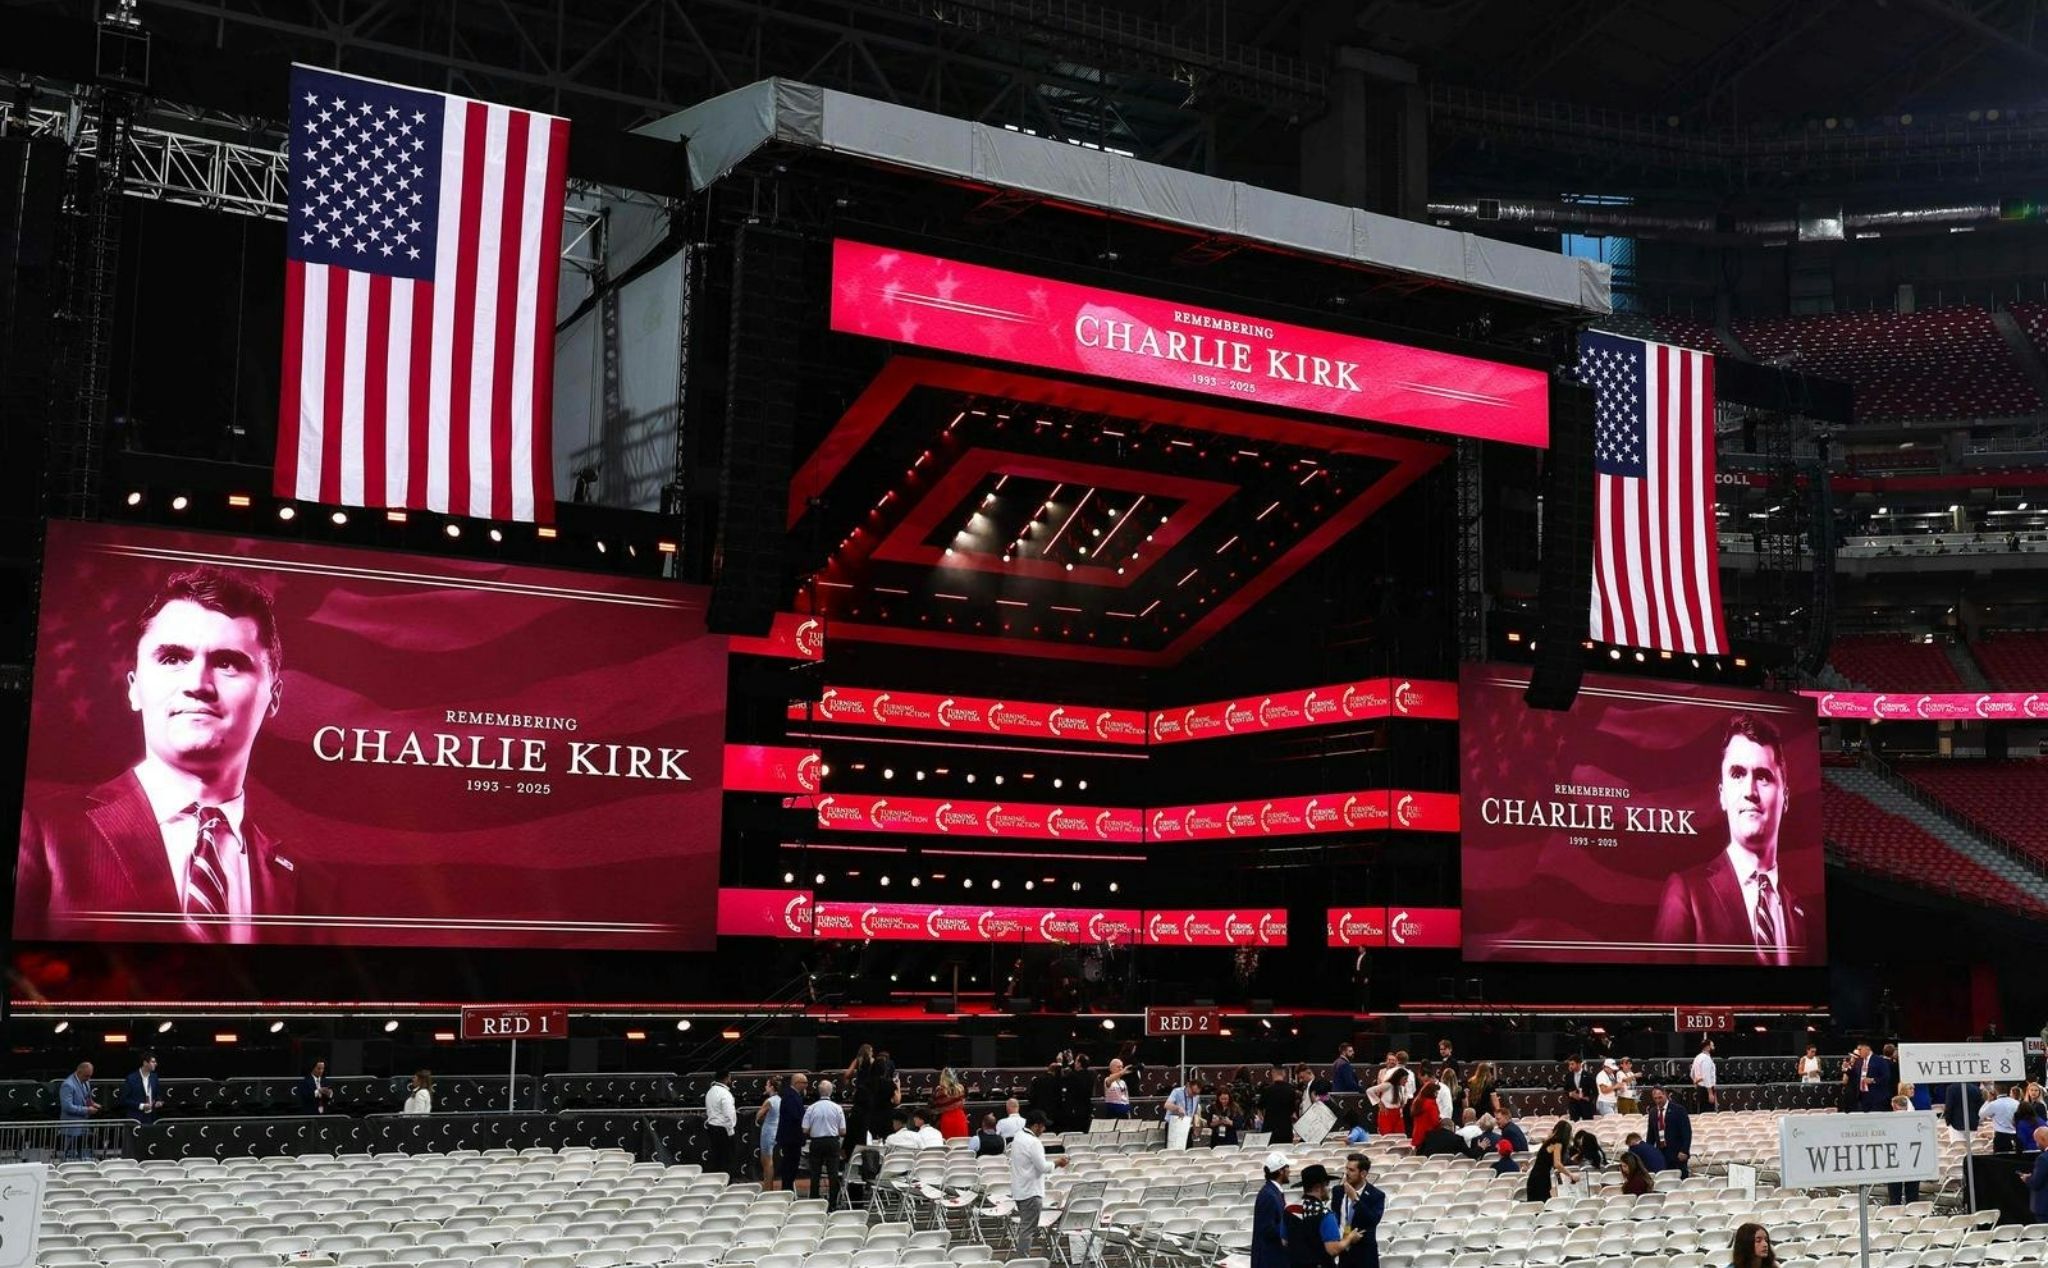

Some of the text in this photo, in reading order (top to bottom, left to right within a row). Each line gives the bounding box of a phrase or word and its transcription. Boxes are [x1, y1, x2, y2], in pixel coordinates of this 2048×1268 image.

[1174, 311, 1274, 340] REMEMBERING
[1075, 315, 1362, 392] CHARLIE KIRK
[1192, 374, 1217, 387] 1993
[1230, 380, 1256, 393] 2025
[445, 710, 578, 731] REMEMBERING
[313, 725, 692, 781] CHARLIE KIRK
[467, 779, 499, 792] 1993
[517, 783, 551, 795] 2025
[1555, 784, 1630, 799] REMEMBERING
[1481, 798, 1698, 835] CHARLIE KIRK
[1569, 836, 1588, 846] 1993
[1598, 838, 1618, 847] 2025
[482, 1016, 549, 1034] RED 1
[1160, 1016, 1208, 1031] RED 2
[1687, 1015, 1725, 1028] RED 3
[1917, 1058, 2011, 1076] WHITE 8
[1805, 1141, 1922, 1174] WHITE 7
